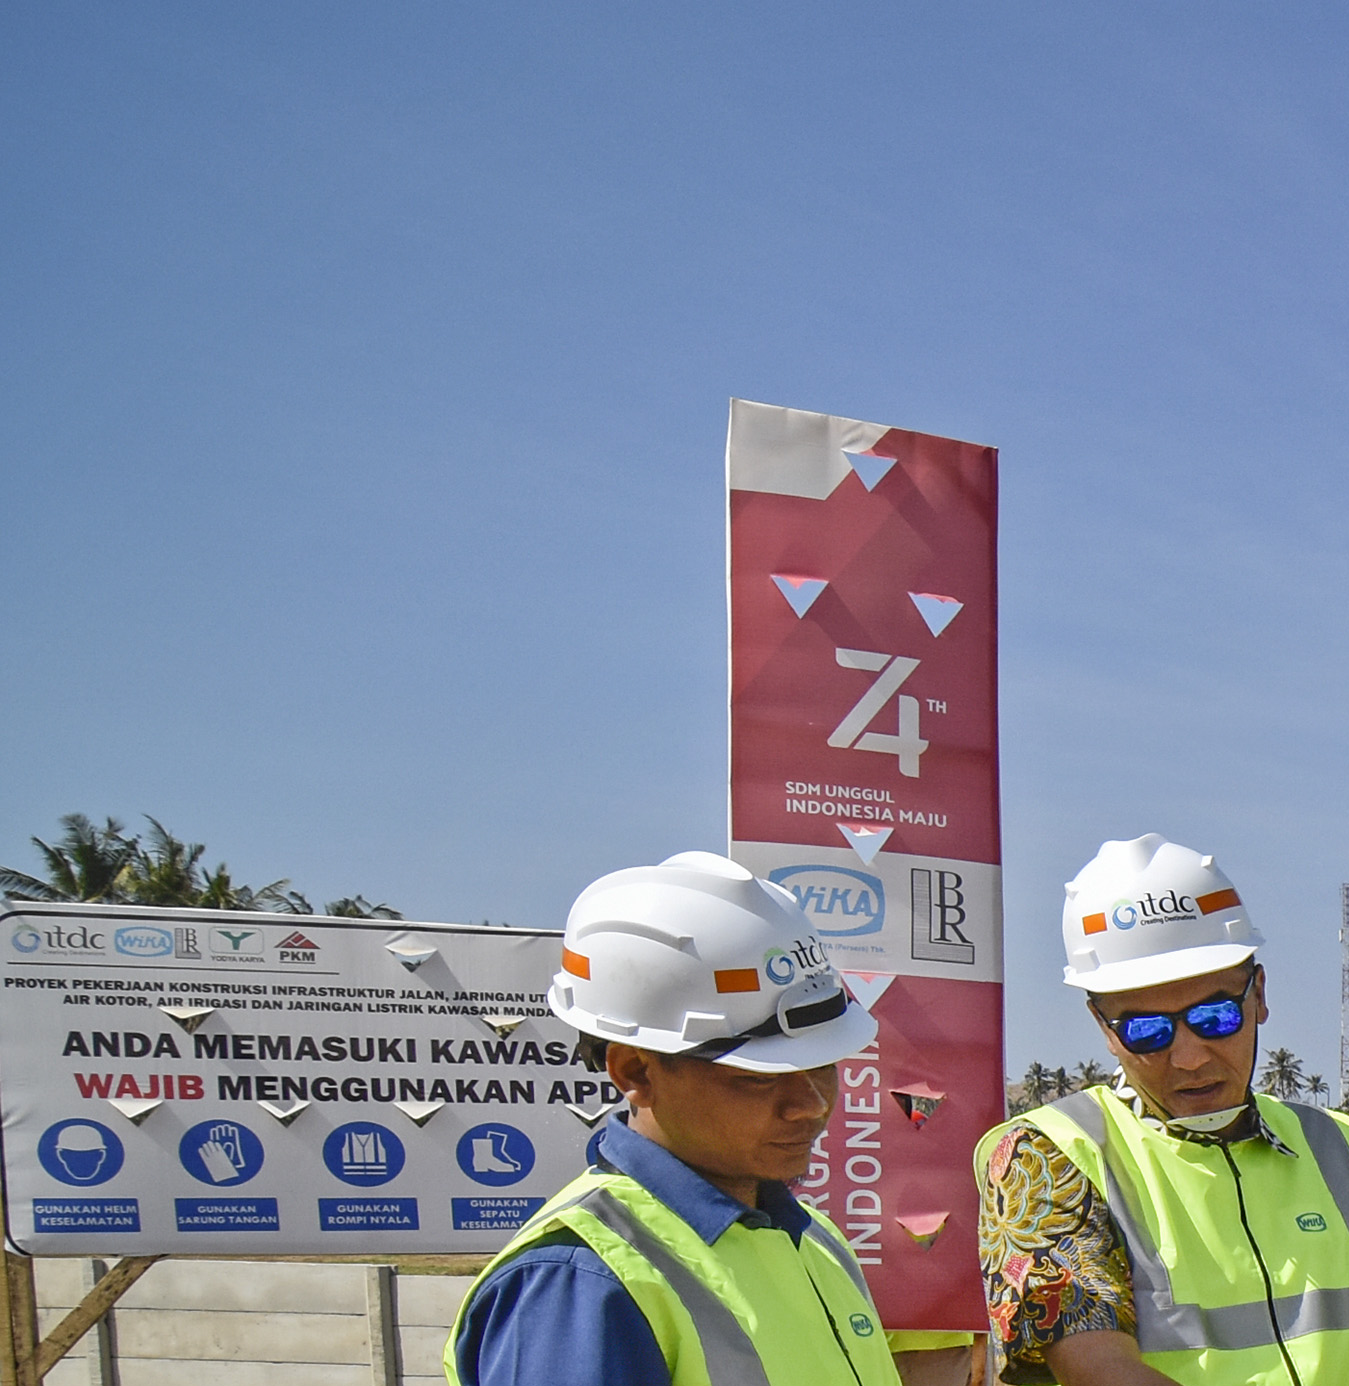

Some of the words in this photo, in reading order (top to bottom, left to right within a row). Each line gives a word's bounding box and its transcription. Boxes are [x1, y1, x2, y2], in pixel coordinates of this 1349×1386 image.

[785, 781, 821, 796] SDM
[825, 785, 895, 804] UNGGUL
[785, 799, 894, 822] INDONESIA
[899, 810, 947, 828] MAJU
[1136, 890, 1194, 916] itdc
[43, 925, 106, 950] itdc
[279, 950, 316, 962] PKM
[4, 977, 68, 989] PROYEK
[72, 979, 164, 992] PEKERJAAN
[169, 982, 268, 995] KONSTRUKSI
[272, 986, 395, 999] INFRASTRUKTUR
[399, 989, 449, 1002] JALAN,
[452, 991, 525, 1002] JARINGAN
[63, 994, 90, 1005] AIR
[95, 995, 152, 1009] KOTOR,
[157, 997, 184, 1007] AIR
[188, 998, 247, 1009] IRIGASI
[251, 1001, 283, 1010] DAN
[287, 1001, 363, 1012] JARINGAN
[367, 1003, 424, 1014] LISTRIK
[428, 1005, 499, 1016] KAWASAN
[503, 1007, 556, 1018] MANDA
[62, 1031, 181, 1058] ANDA
[193, 1034, 416, 1063] MEMASUKI
[74, 1073, 205, 1099] WAJIB
[218, 1075, 535, 1104] MENGGUNAKAN
[844, 1040, 882, 1265] INDONESI
[197, 1205, 257, 1213] GUNAKAN
[337, 1204, 400, 1213] GUNAKAN
[470, 1199, 528, 1207] GUNAKAN
[34, 1205, 101, 1214] GUNAKAN
[104, 1205, 137, 1213] HELM
[480, 1210, 520, 1218] SEPATU
[41, 1217, 133, 1226] KESELAMATAN
[178, 1216, 225, 1224] SARUNG
[228, 1216, 277, 1224] TANGAN
[328, 1216, 367, 1225] ROMPI
[370, 1216, 410, 1224] NYALA
[461, 1221, 524, 1229] KESELAMAT
